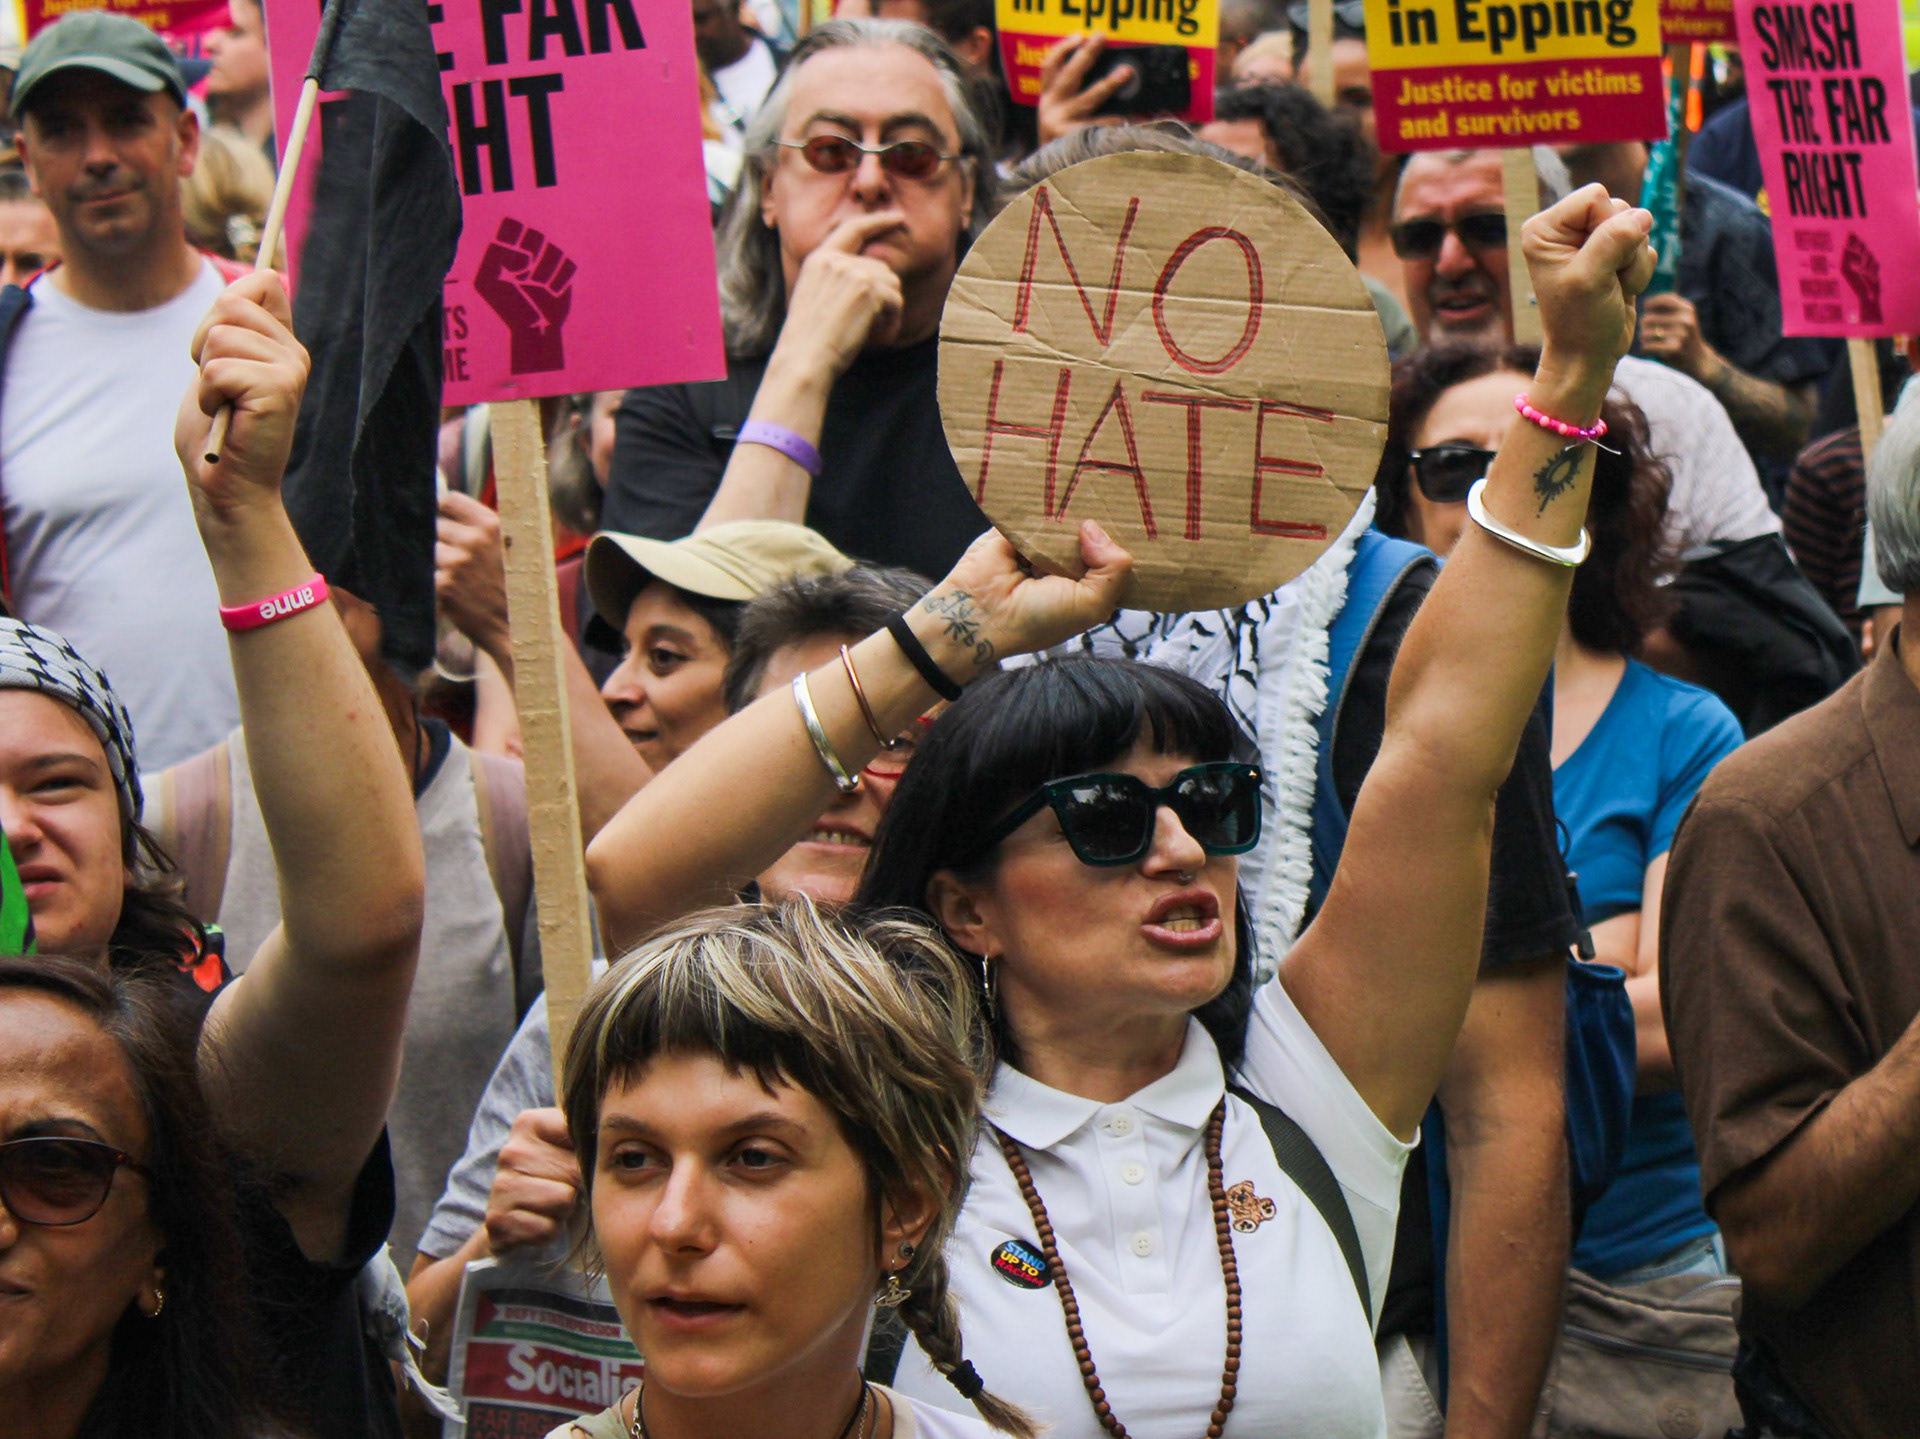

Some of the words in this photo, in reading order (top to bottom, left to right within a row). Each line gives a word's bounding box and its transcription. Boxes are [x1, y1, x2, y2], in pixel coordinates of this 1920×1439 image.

[1388, 0, 1438, 46] in
[1456, 0, 1637, 54] Epping
[1754, 3, 1862, 71] SMASH
[1397, 78, 1493, 106] Justice
[1499, 72, 1539, 99] for
[1545, 67, 1643, 97] victims
[1766, 77, 1821, 144] THE
[1822, 77, 1891, 144] FAR
[1400, 111, 1450, 139] and
[1455, 108, 1582, 136] survivors
[1782, 150, 1867, 219] RIGHT
[1012, 186, 1264, 375] NO
[975, 359, 1335, 541] HATE
[259, 586, 315, 620] anne
[1000, 1250, 1020, 1264] UP
[1021, 1261, 1039, 1277] TO
[1004, 1241, 1046, 1271] STAND
